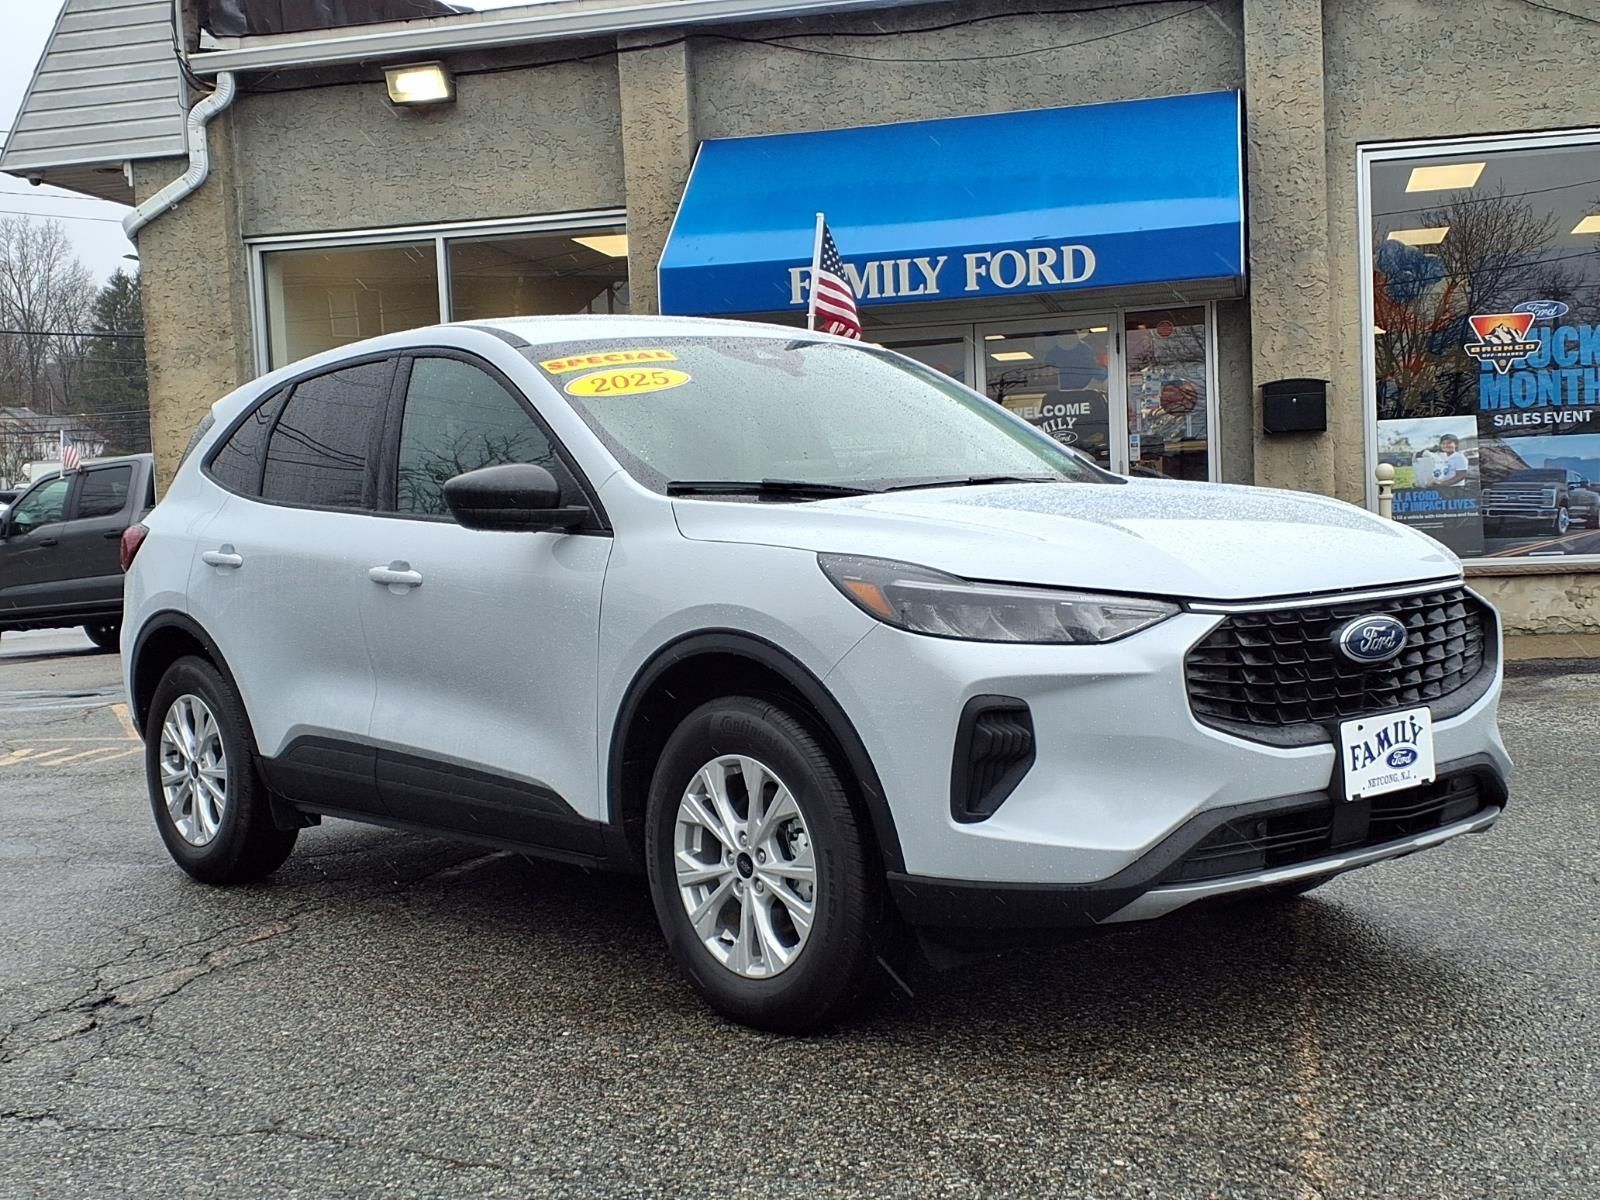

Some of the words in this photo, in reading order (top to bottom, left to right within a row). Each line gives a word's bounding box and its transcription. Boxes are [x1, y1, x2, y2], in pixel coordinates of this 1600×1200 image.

[789, 255, 948, 305] FMILY
[963, 244, 1097, 291] FORD
[1470, 344, 1535, 353] BRONCO
[1480, 325, 1600, 370] UCK
[547, 350, 671, 371] SPECIAL
[590, 371, 670, 393] 2025
[1479, 366, 1600, 410] MONTH
[1009, 402, 1091, 419] WELCOME
[1493, 412, 1541, 427] SALES
[1543, 409, 1593, 424] EVENT
[1038, 416, 1077, 433] MILY
[1392, 502, 1409, 513] ELP
[1410, 500, 1447, 512] IMPACT
[1447, 498, 1479, 511] LIVES.
[1405, 492, 1412, 502] A
[1412, 490, 1442, 501] FORD.
[1350, 719, 1424, 772] FAMILY
